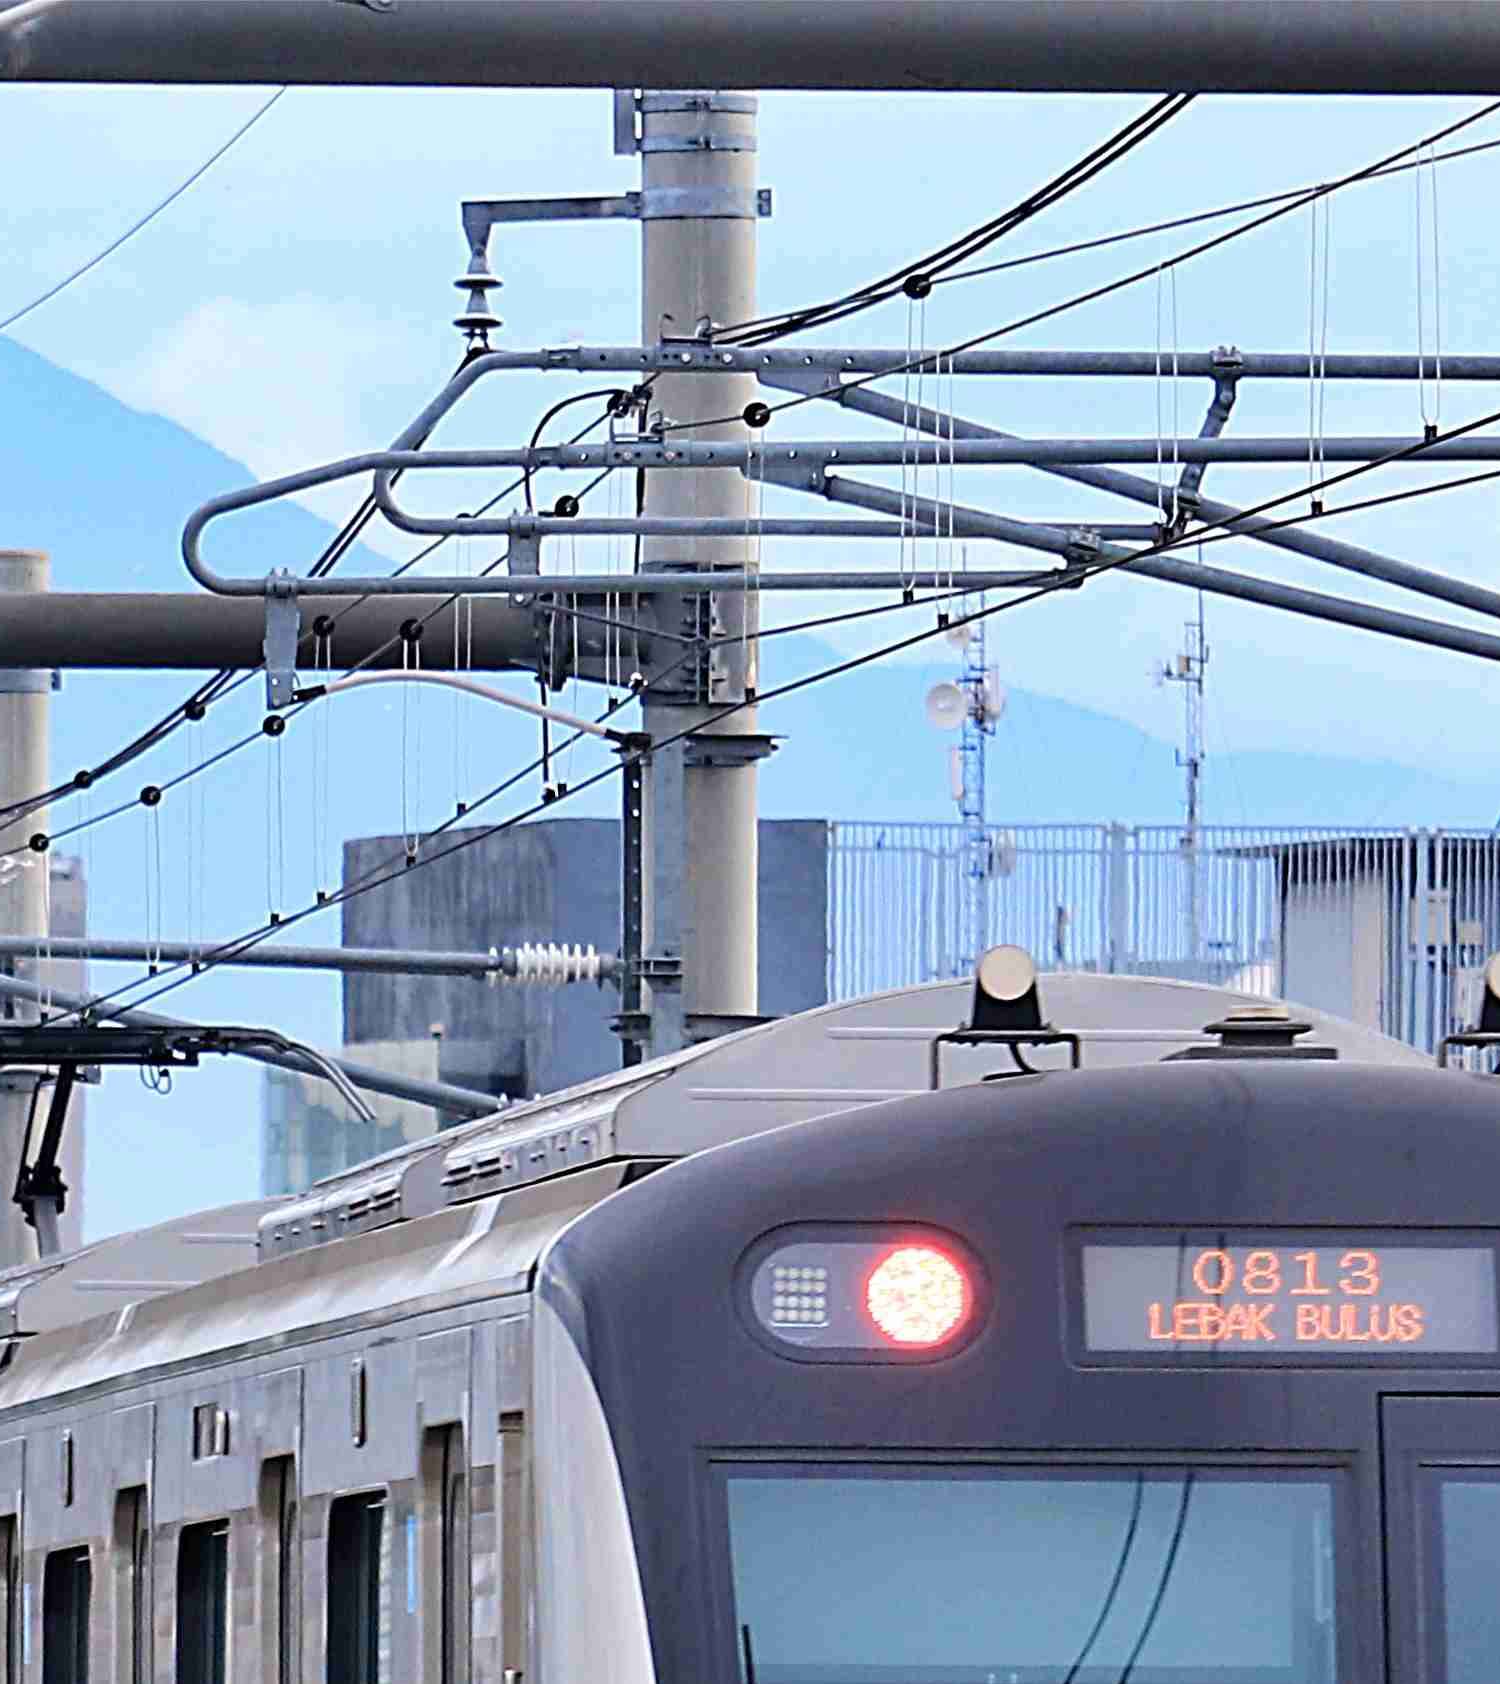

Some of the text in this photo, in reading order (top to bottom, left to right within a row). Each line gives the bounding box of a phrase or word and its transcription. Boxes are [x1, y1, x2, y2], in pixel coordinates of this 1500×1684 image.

[1192, 1249, 1380, 1296] 0813
[1148, 1302, 1425, 1342] LEBAK BULUS
